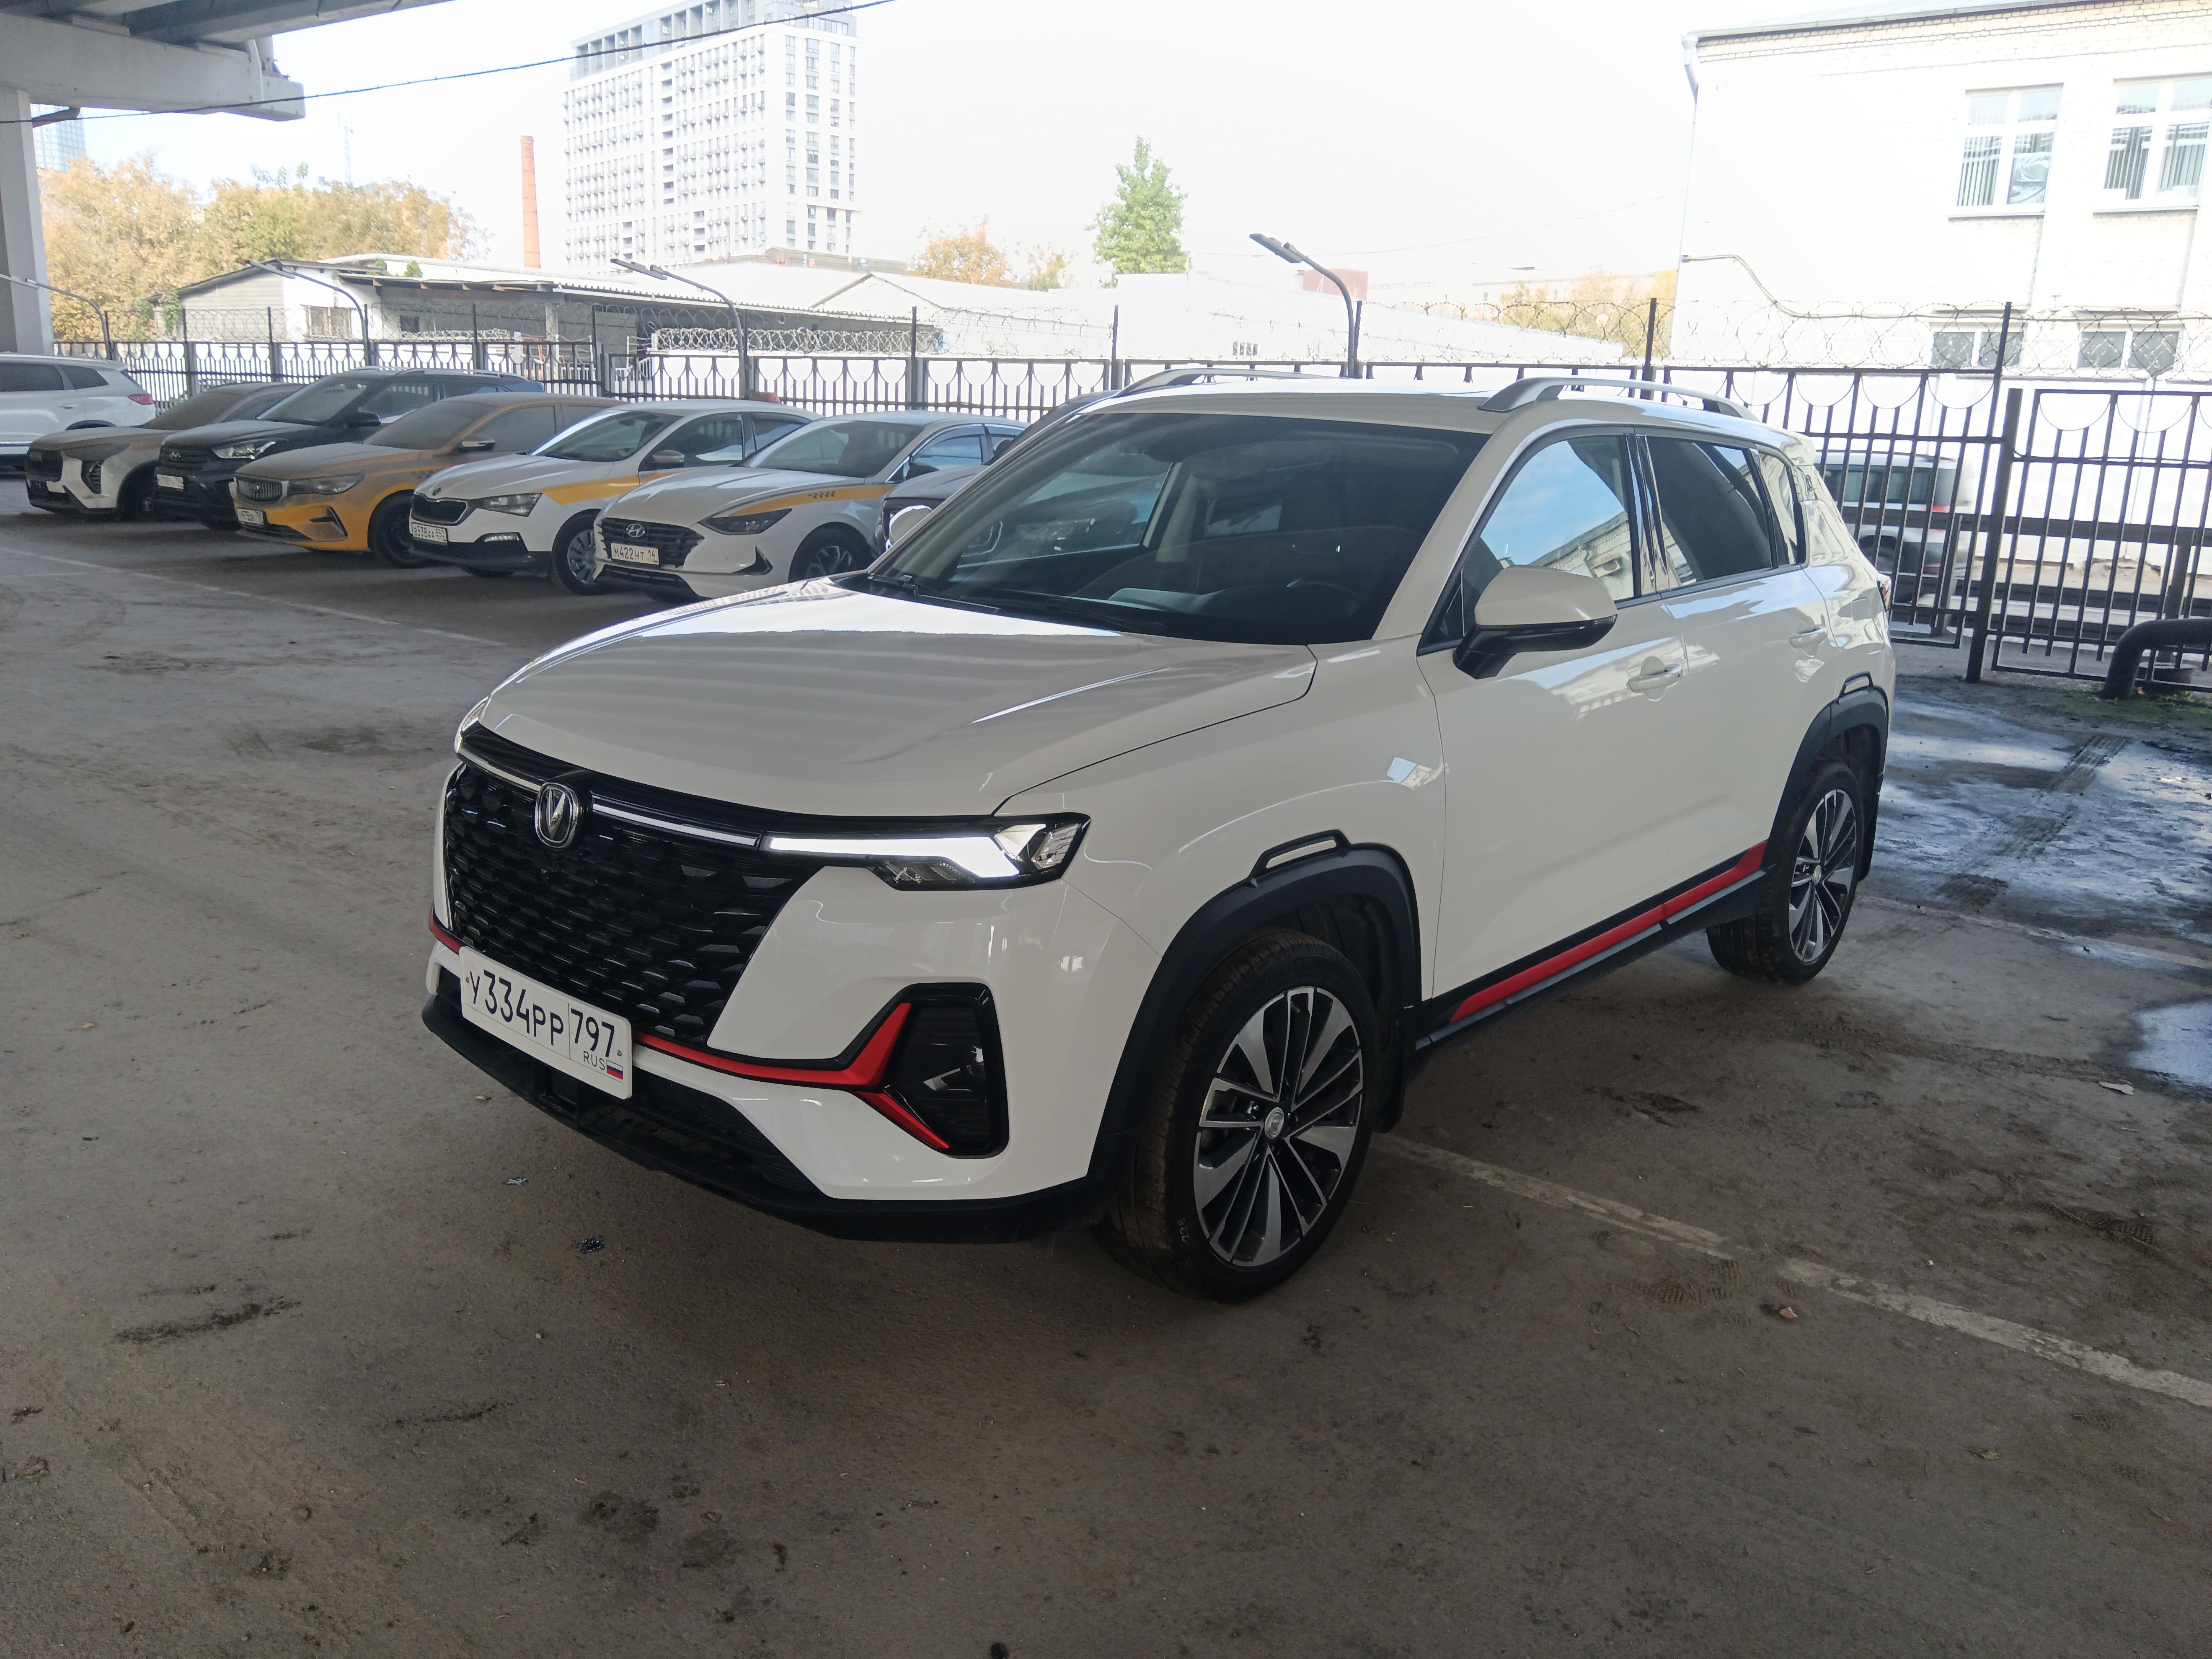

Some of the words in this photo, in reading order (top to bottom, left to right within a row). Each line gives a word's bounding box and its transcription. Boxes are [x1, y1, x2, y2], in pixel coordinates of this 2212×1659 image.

[614, 546, 645, 561] М422НТ
[647, 549, 656, 560] 14
[470, 969, 564, 1046] У334РР
[571, 1008, 615, 1058] 797
[583, 1050, 605, 1071] RUS
